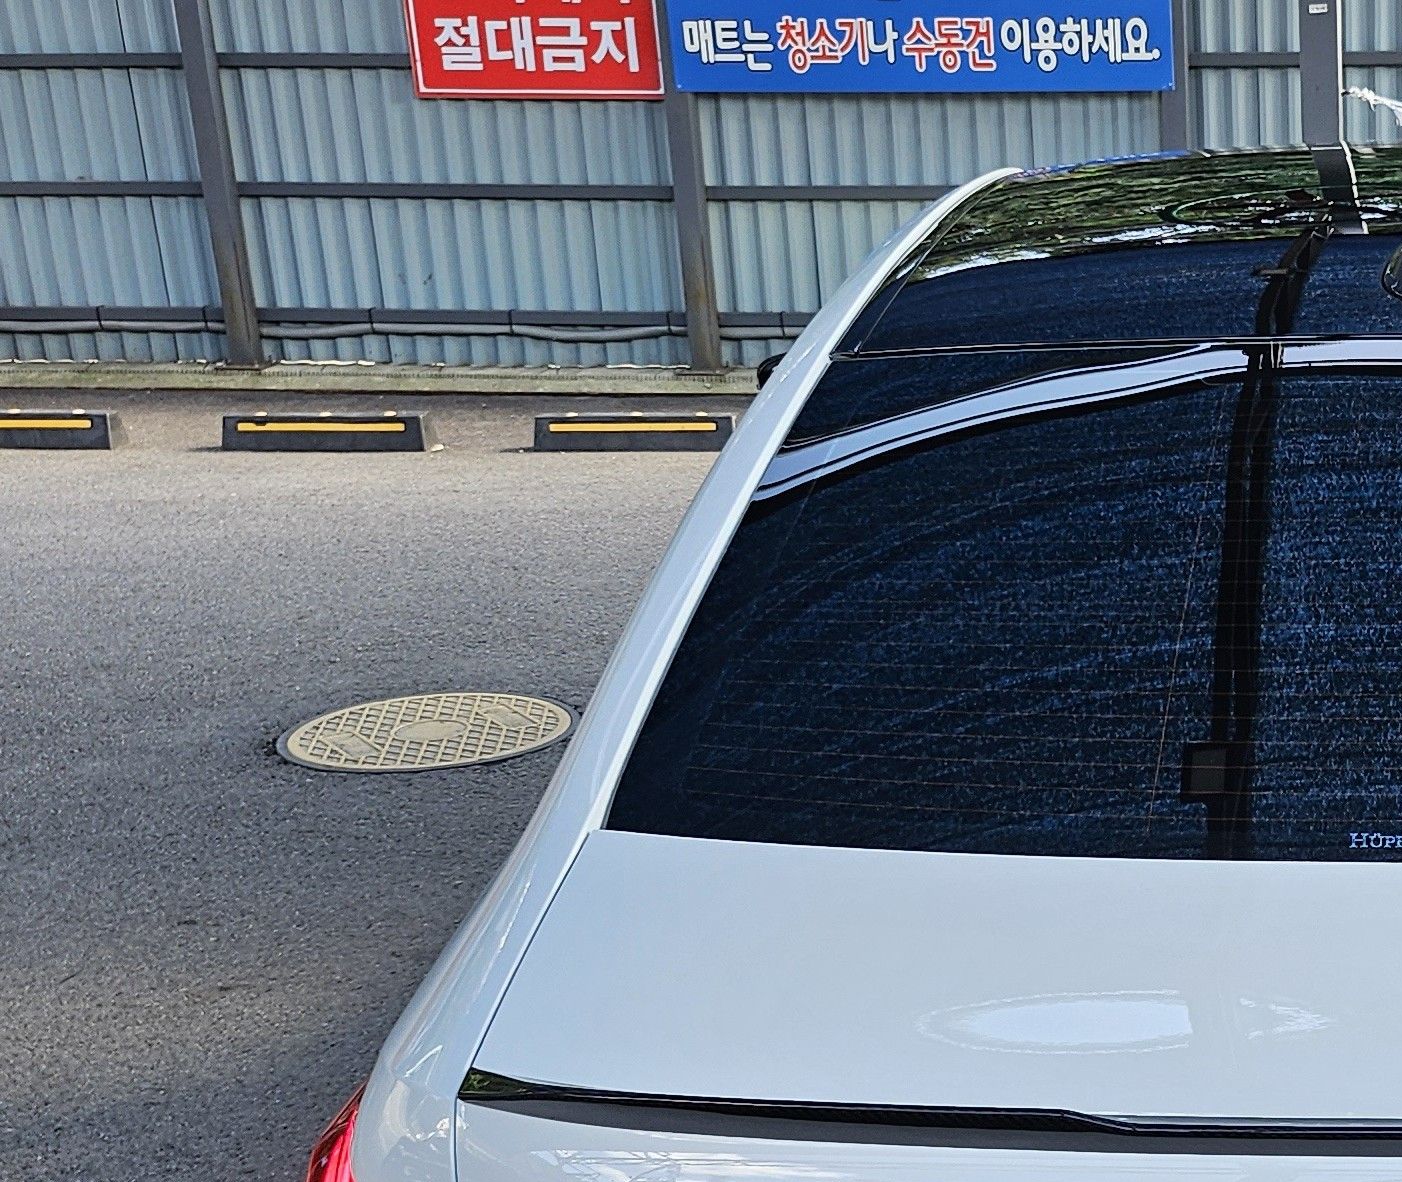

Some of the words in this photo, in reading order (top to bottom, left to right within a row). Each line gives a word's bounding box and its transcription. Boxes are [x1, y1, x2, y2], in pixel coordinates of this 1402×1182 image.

[434, 16, 640, 73] 절대금지
[682, 19, 774, 71] 매트는
[776, 15, 899, 74] 청소기나
[902, 17, 997, 73] 수동건
[1000, 16, 1161, 72] 이용하세요.
